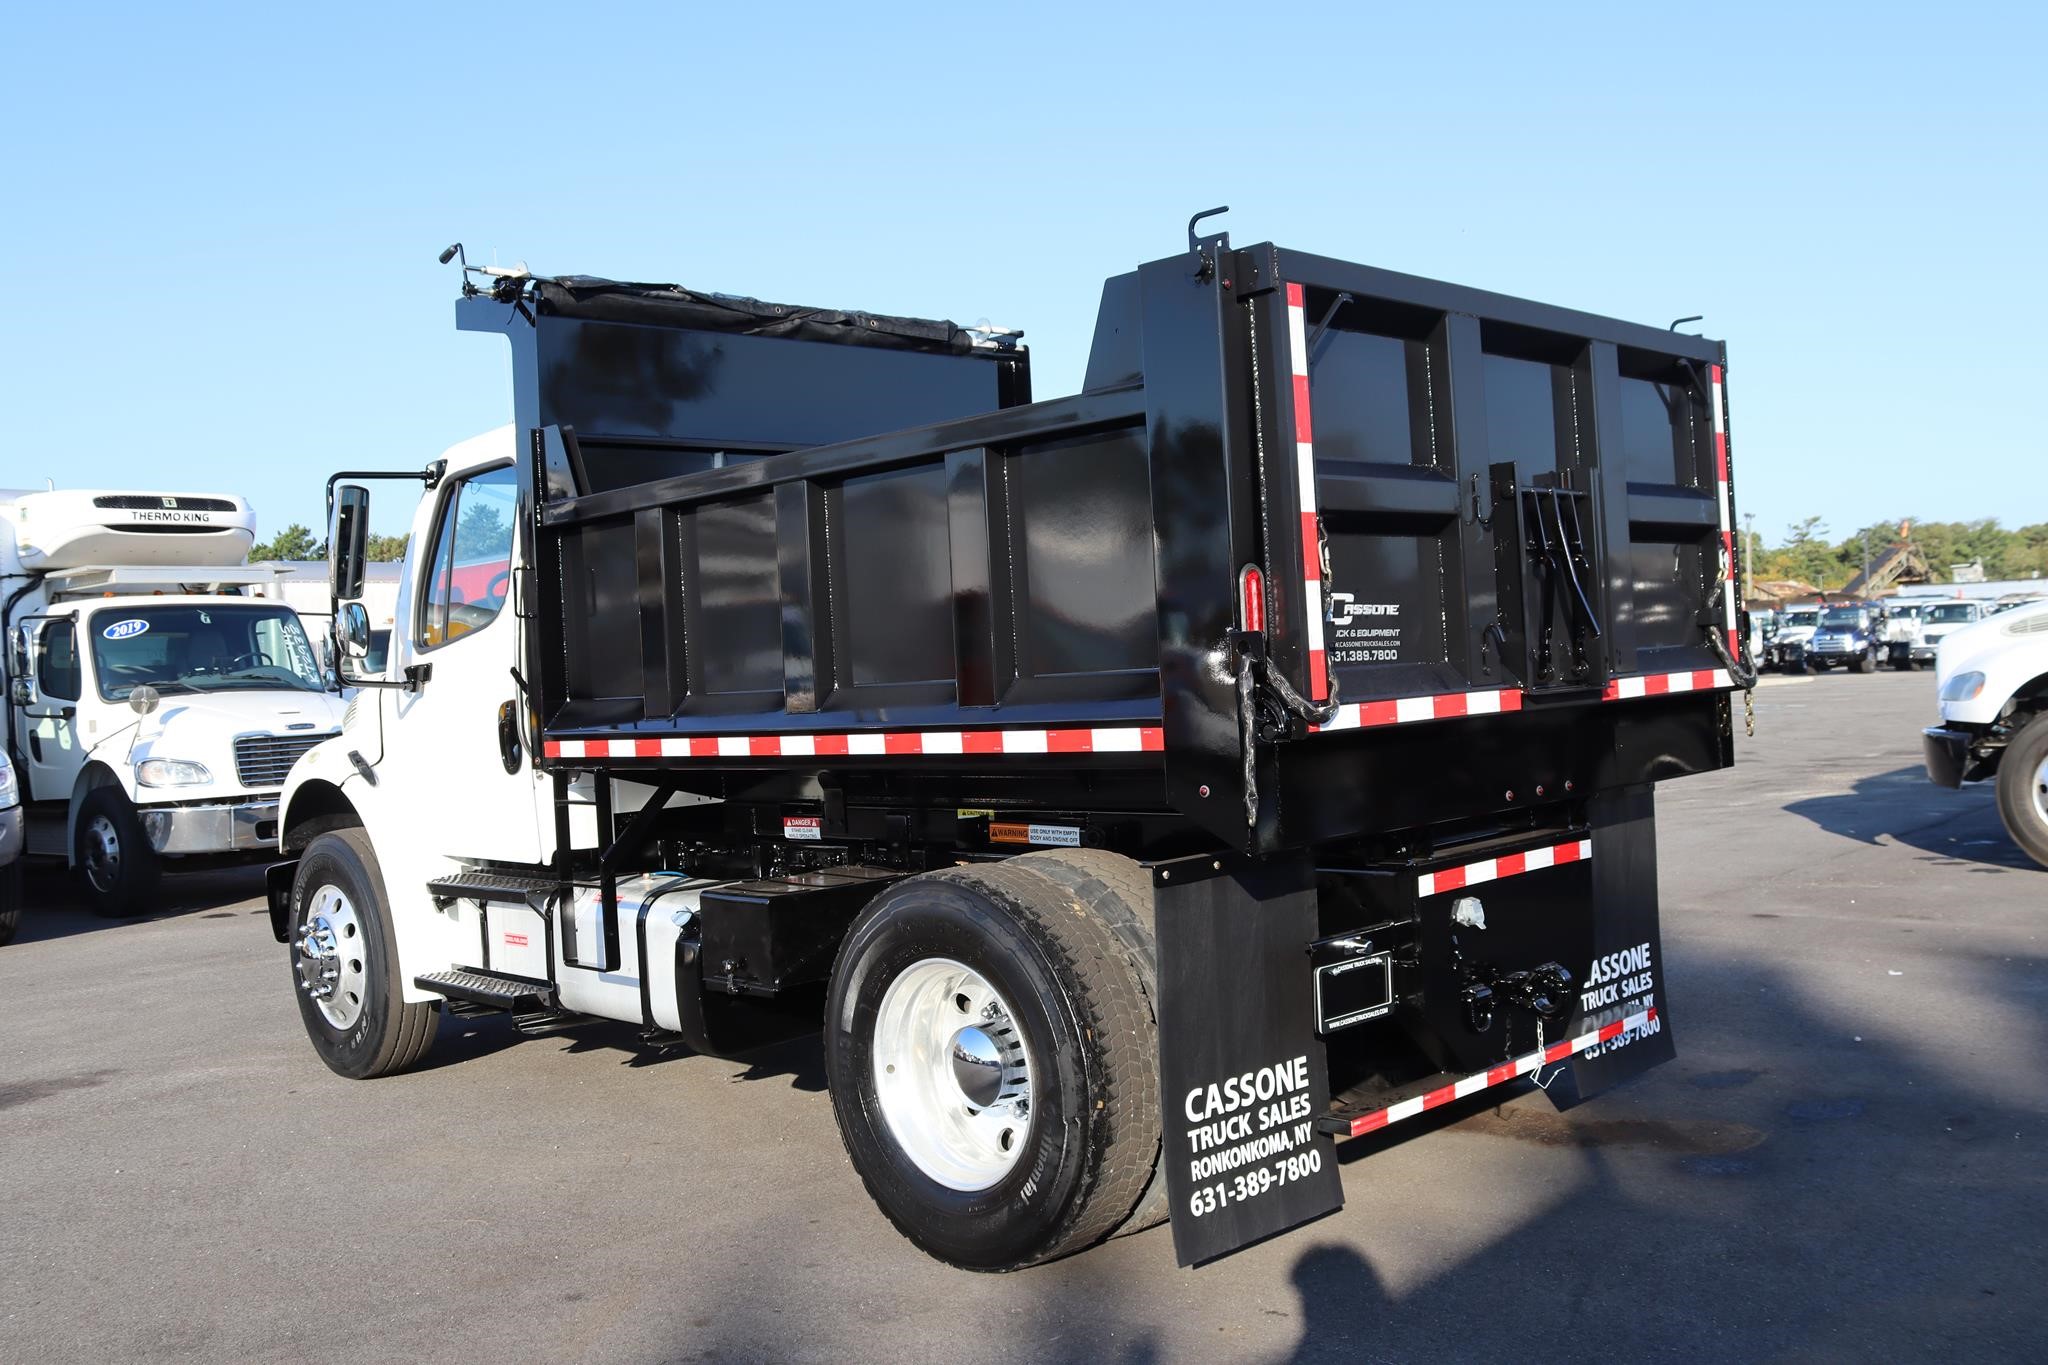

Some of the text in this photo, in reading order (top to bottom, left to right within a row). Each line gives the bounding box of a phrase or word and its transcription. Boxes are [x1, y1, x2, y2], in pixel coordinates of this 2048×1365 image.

[132, 511, 210, 522] THERMO KING
[112, 621, 142, 637] 2019
[1350, 629, 1356, 637] &
[1357, 629, 1400, 637] EQUIPMENT
[997, 828, 1028, 838] WARNING
[1580, 971, 1653, 1012] TRUCK SALES
[1185, 1055, 1310, 1123] CASSONE
[1187, 1092, 1312, 1154] TRUCK SALES
[1190, 1120, 1313, 1182] RONKONKOMA, NY
[1189, 1148, 1322, 1217] 631-389-7800
